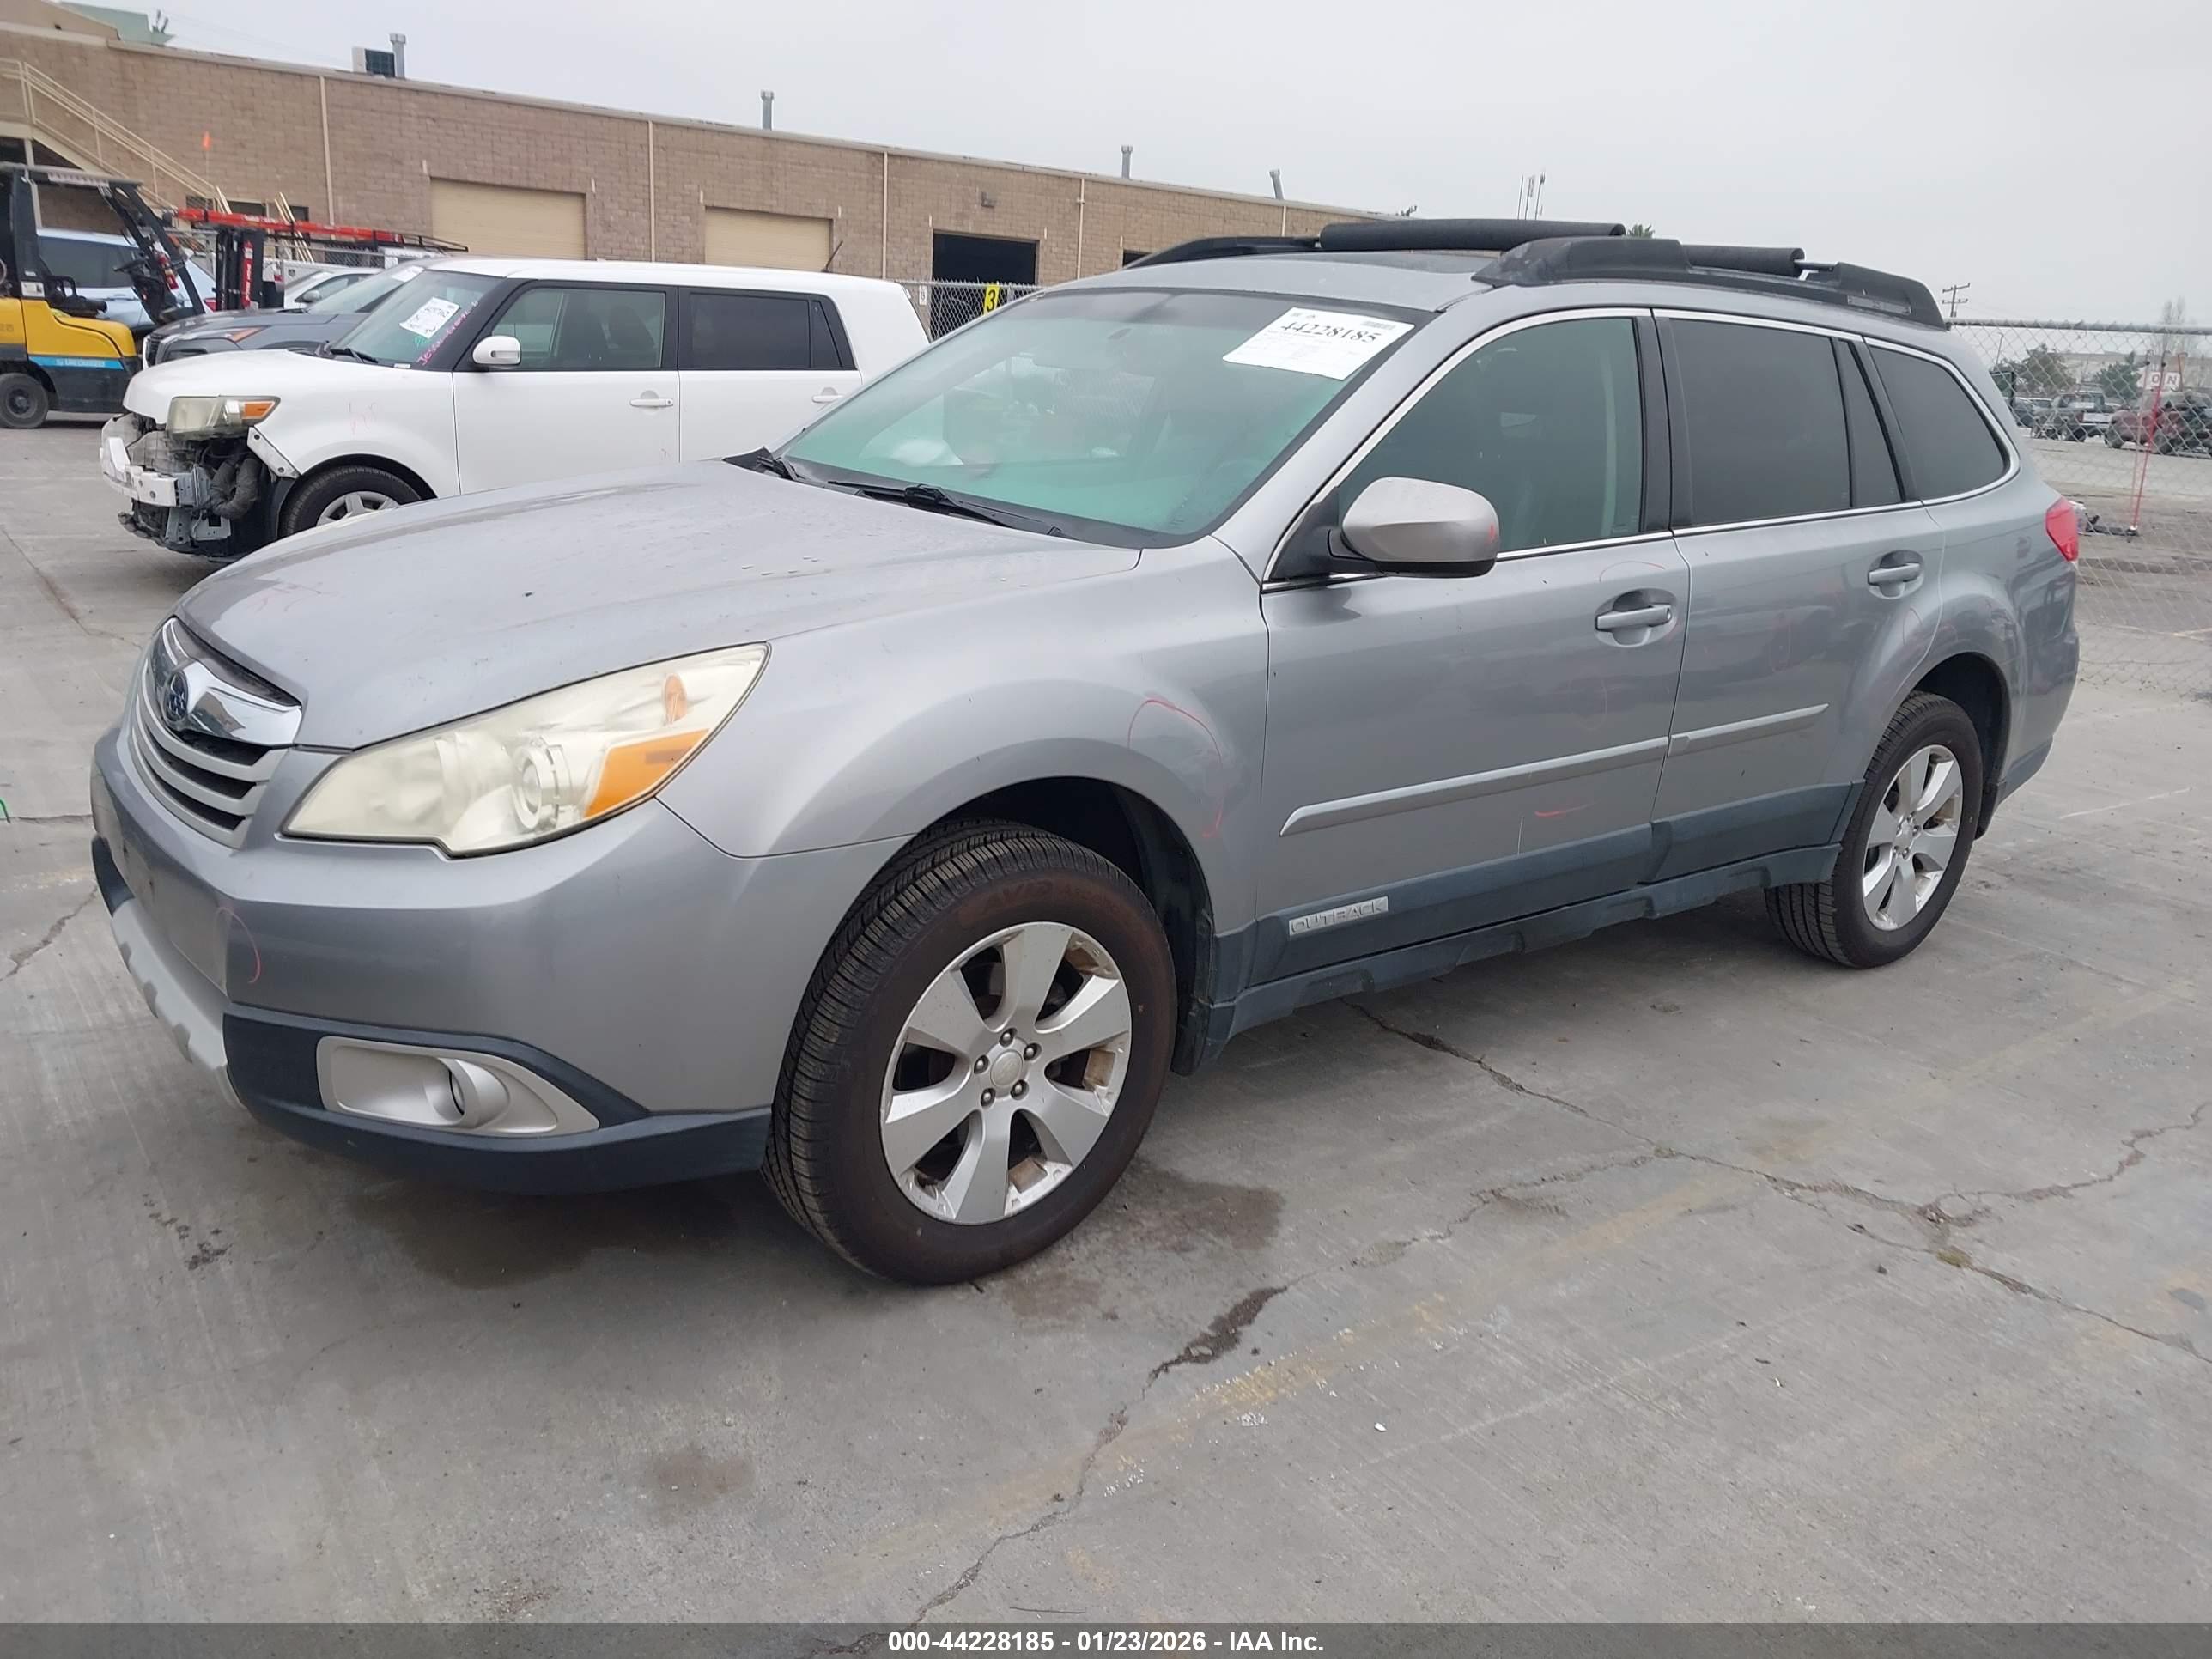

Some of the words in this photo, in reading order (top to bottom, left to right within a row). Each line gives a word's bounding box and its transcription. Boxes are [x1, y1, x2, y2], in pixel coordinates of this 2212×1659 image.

[987, 289, 996, 312] 3
[1280, 321, 1382, 343] 44228185
[1291, 896, 1386, 933] OUTBACK
